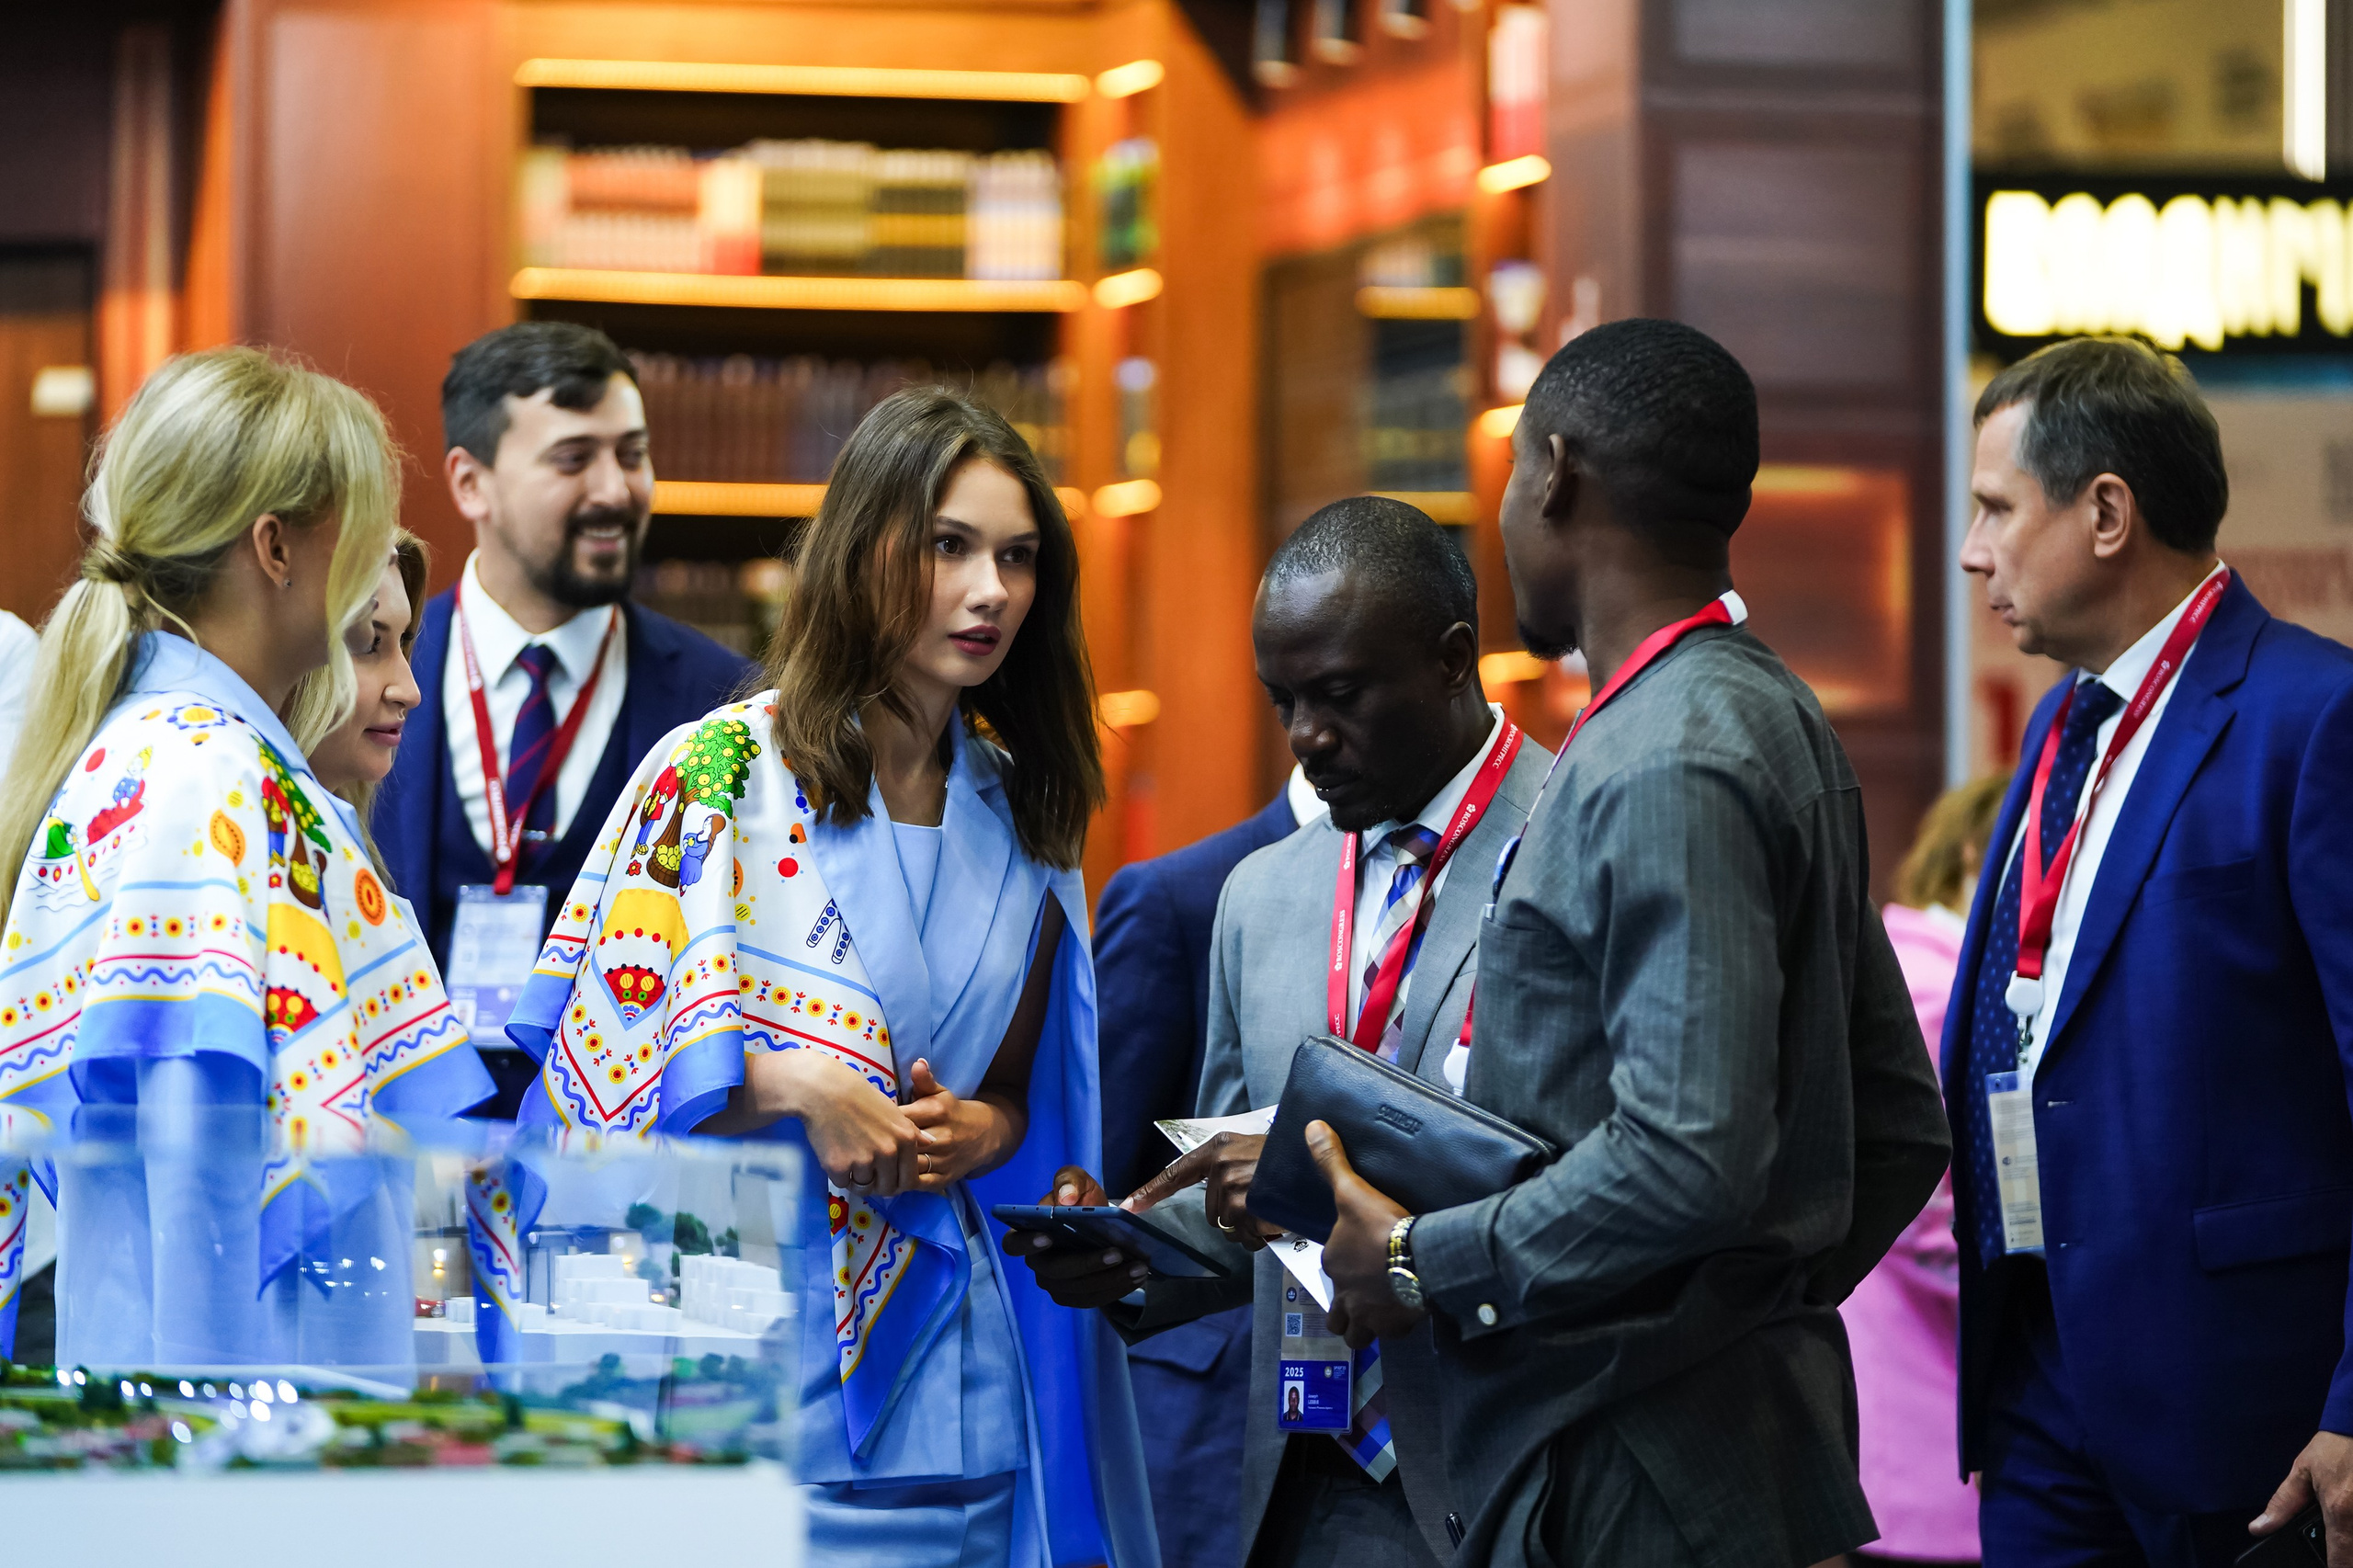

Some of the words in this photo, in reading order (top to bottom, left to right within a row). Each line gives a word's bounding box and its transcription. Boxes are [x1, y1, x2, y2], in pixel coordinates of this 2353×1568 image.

[1438, 811, 1472, 862] ROSCONGRESS
[1336, 909, 1346, 962] ROSCONGRESS
[1284, 1367, 1304, 1377] 2025
